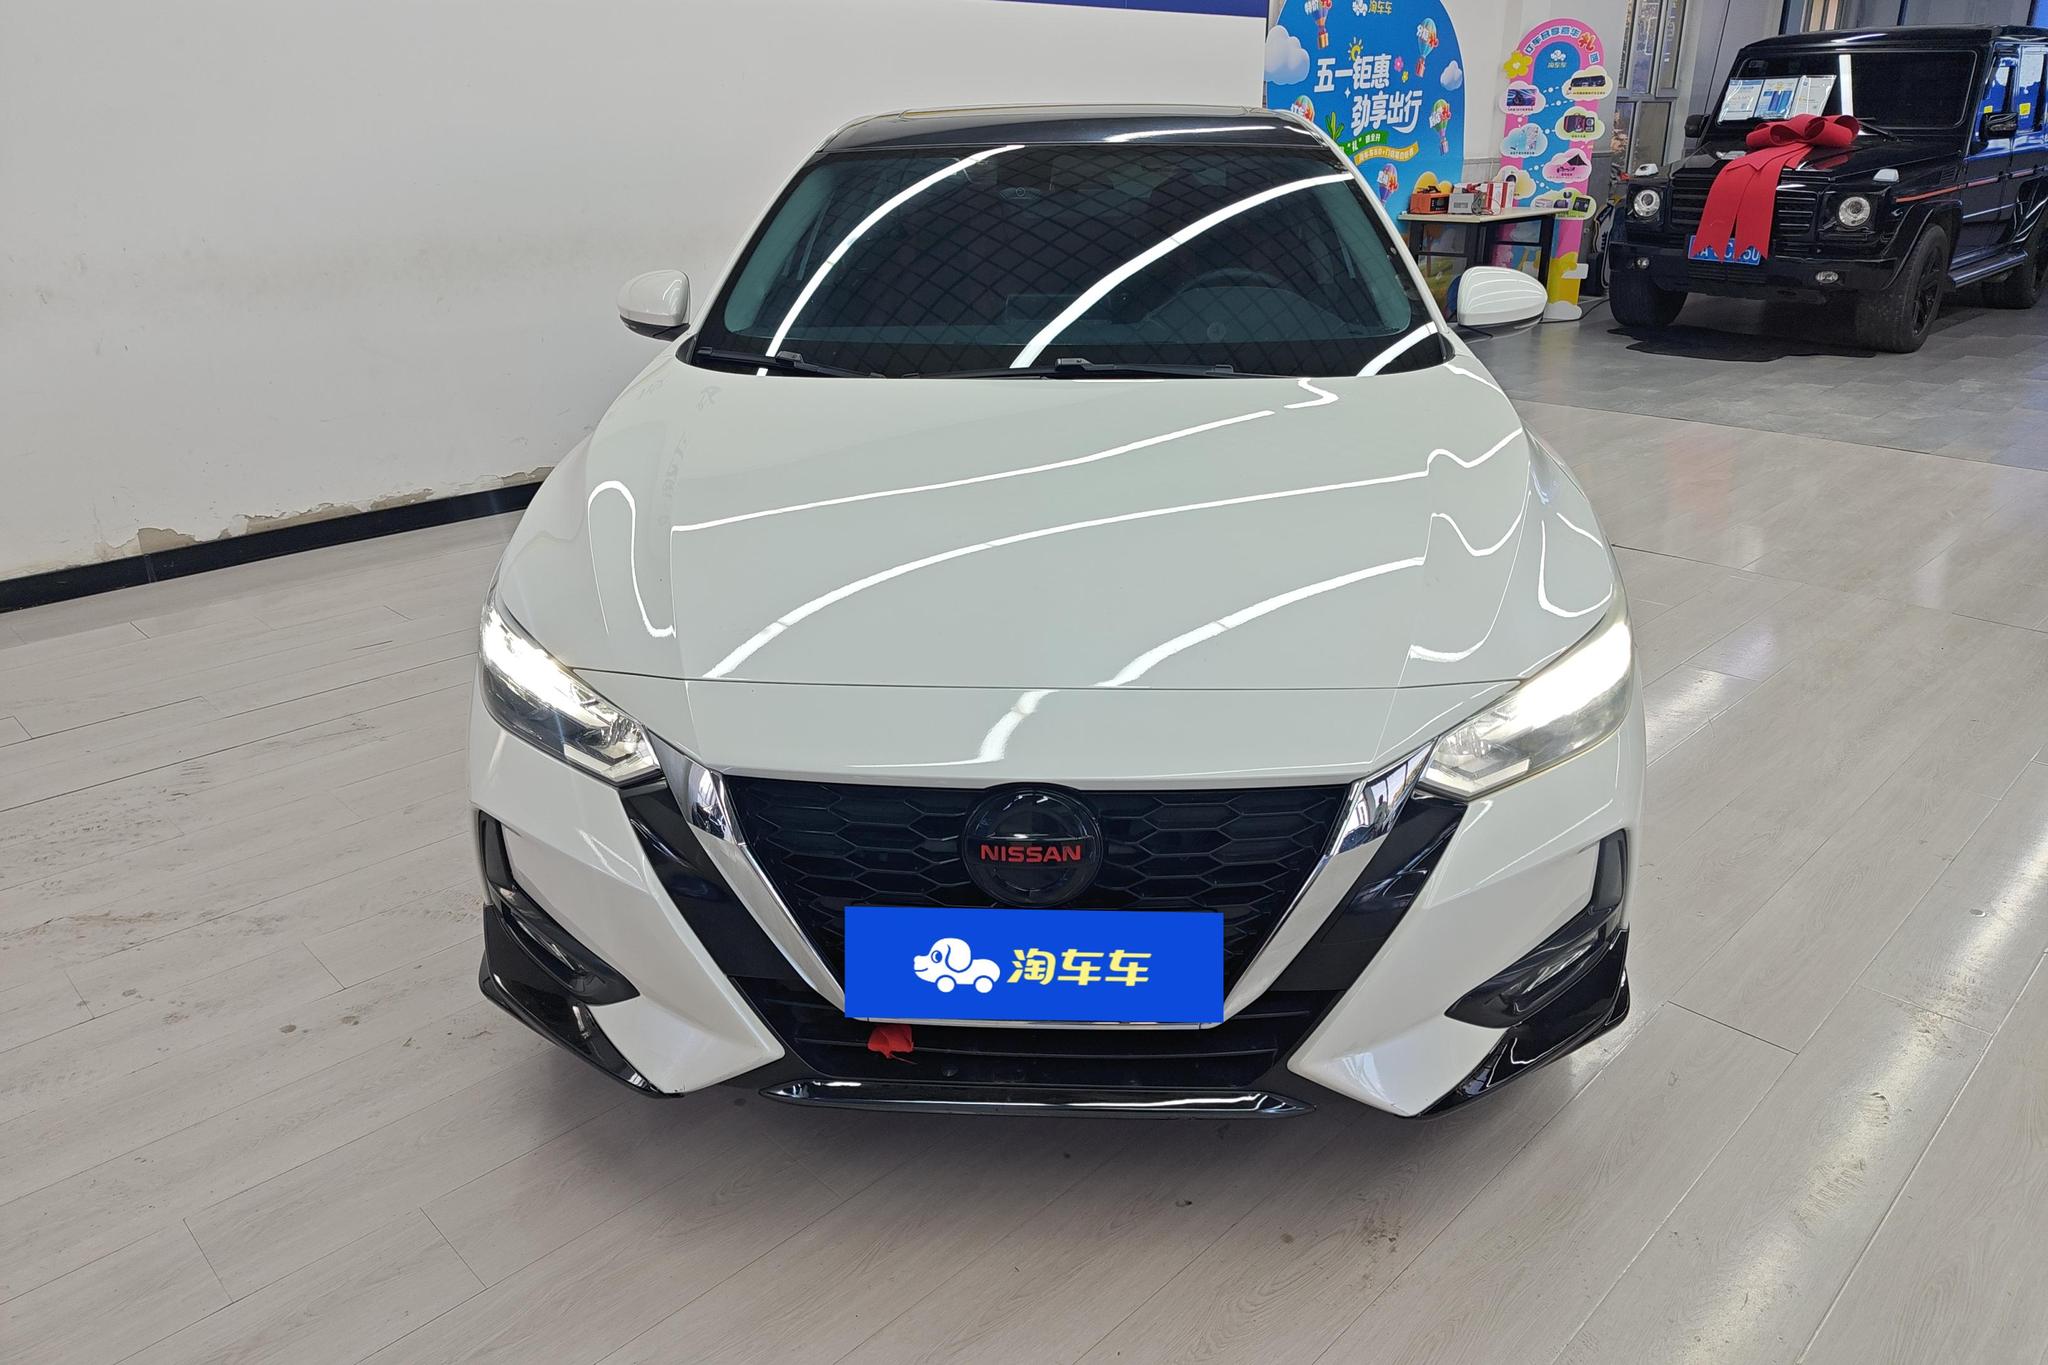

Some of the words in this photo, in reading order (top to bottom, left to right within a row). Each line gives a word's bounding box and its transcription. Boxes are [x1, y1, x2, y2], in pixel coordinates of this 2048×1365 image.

[1313, 53, 1392, 93] 五一钜惠
[1350, 90, 1423, 136] 劲享出行
[980, 844, 1081, 863] NISSAN
